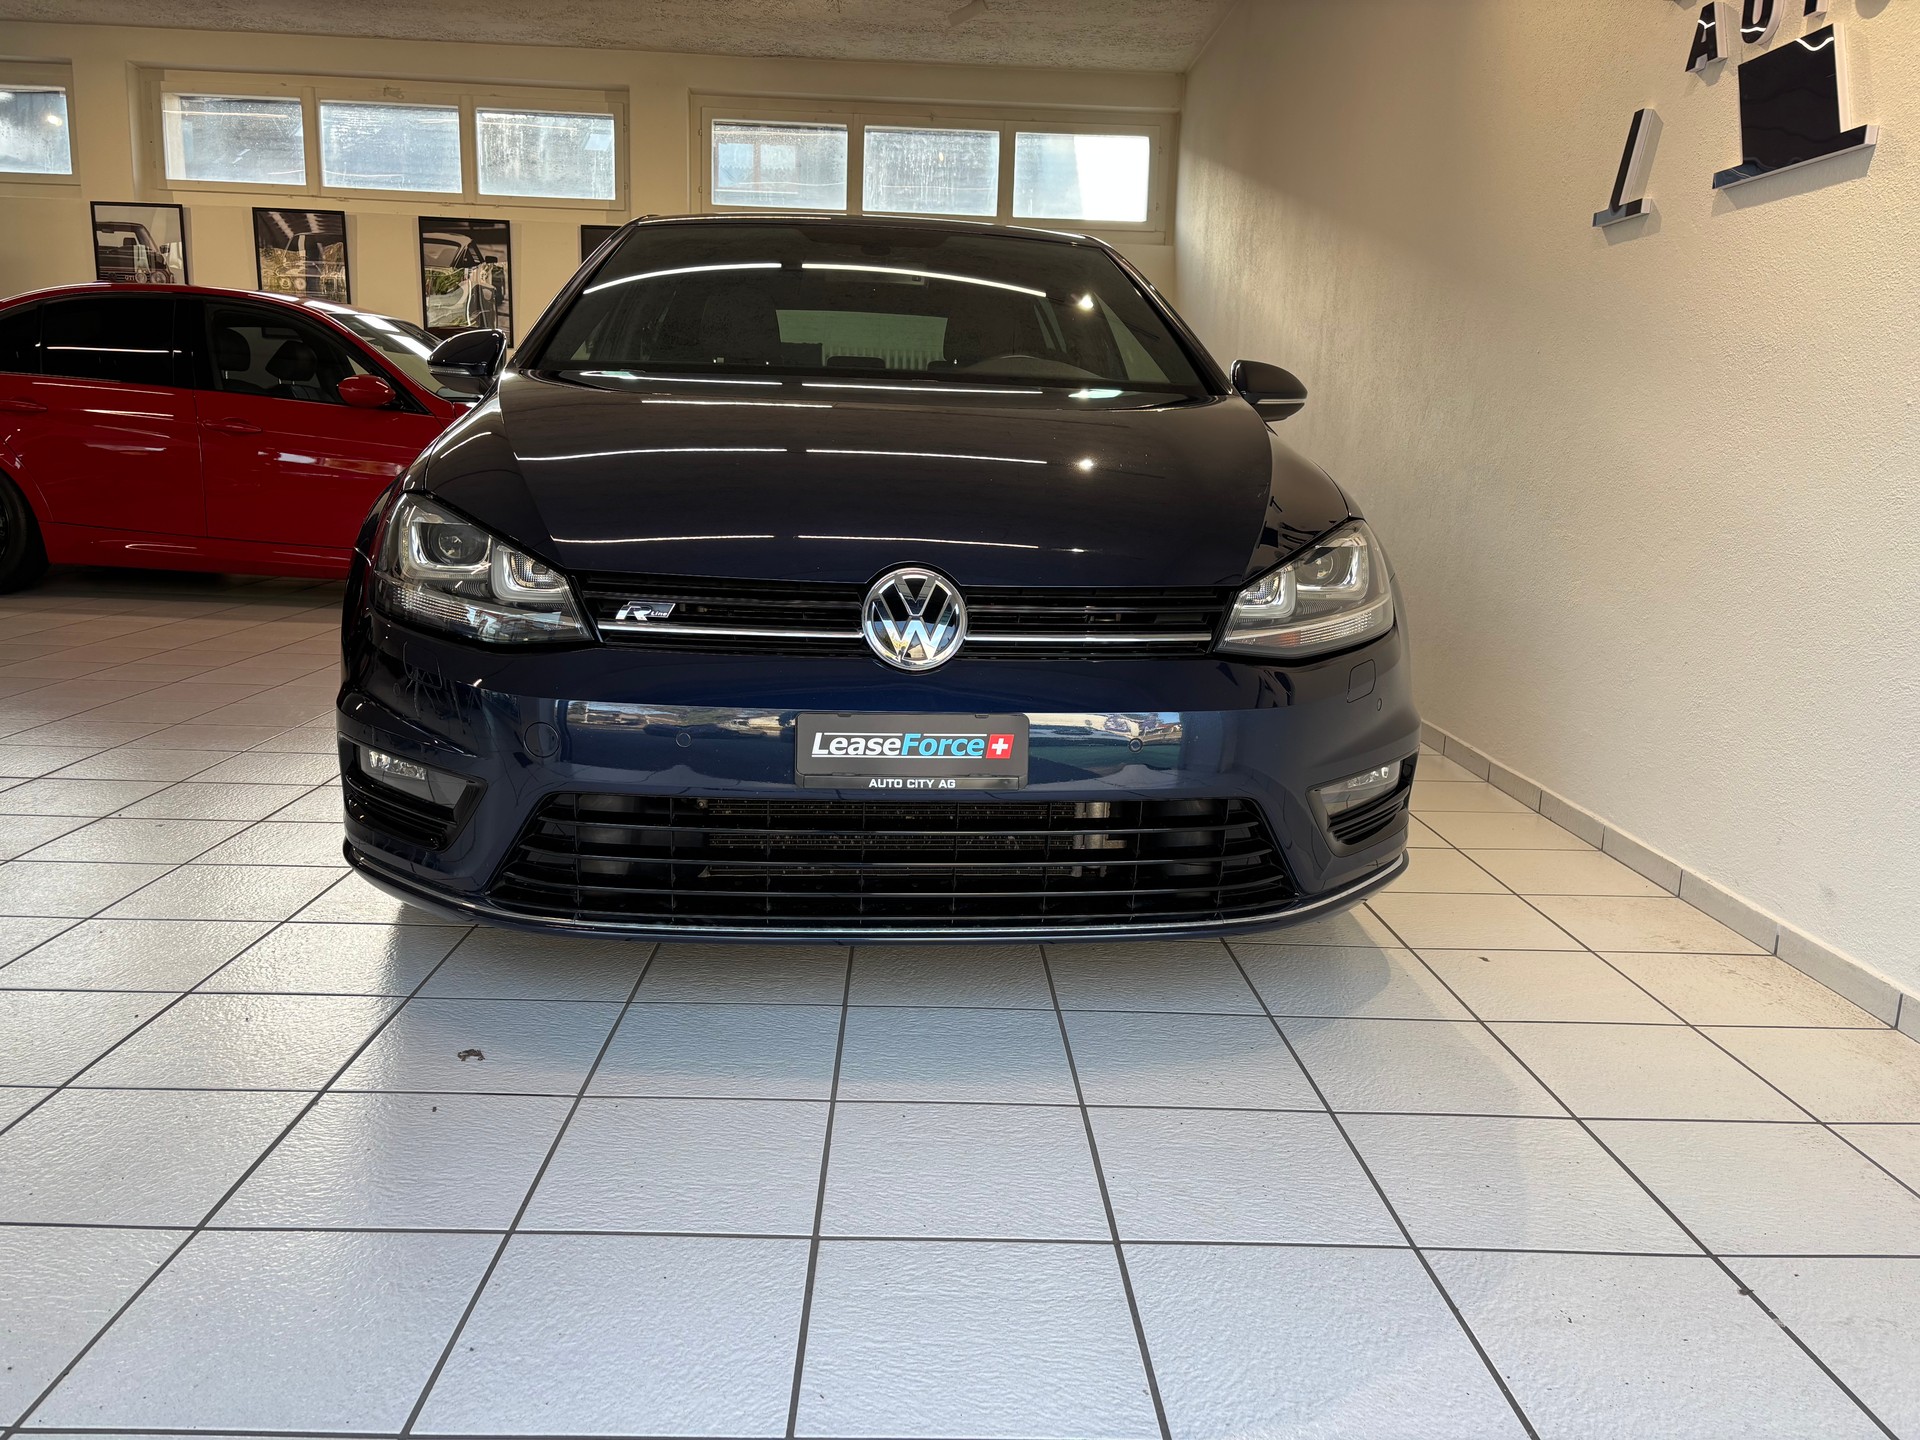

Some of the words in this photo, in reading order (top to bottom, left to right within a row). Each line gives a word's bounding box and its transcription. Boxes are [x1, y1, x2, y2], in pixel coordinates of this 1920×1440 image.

[1685, 0, 1826, 72] AU
[615, 605, 652, 621] R
[866, 571, 963, 664] VW
[811, 732, 985, 756] LeaseForce
[868, 778, 903, 788] AUTO
[906, 779, 935, 789] CITY
[938, 779, 956, 789] AG
